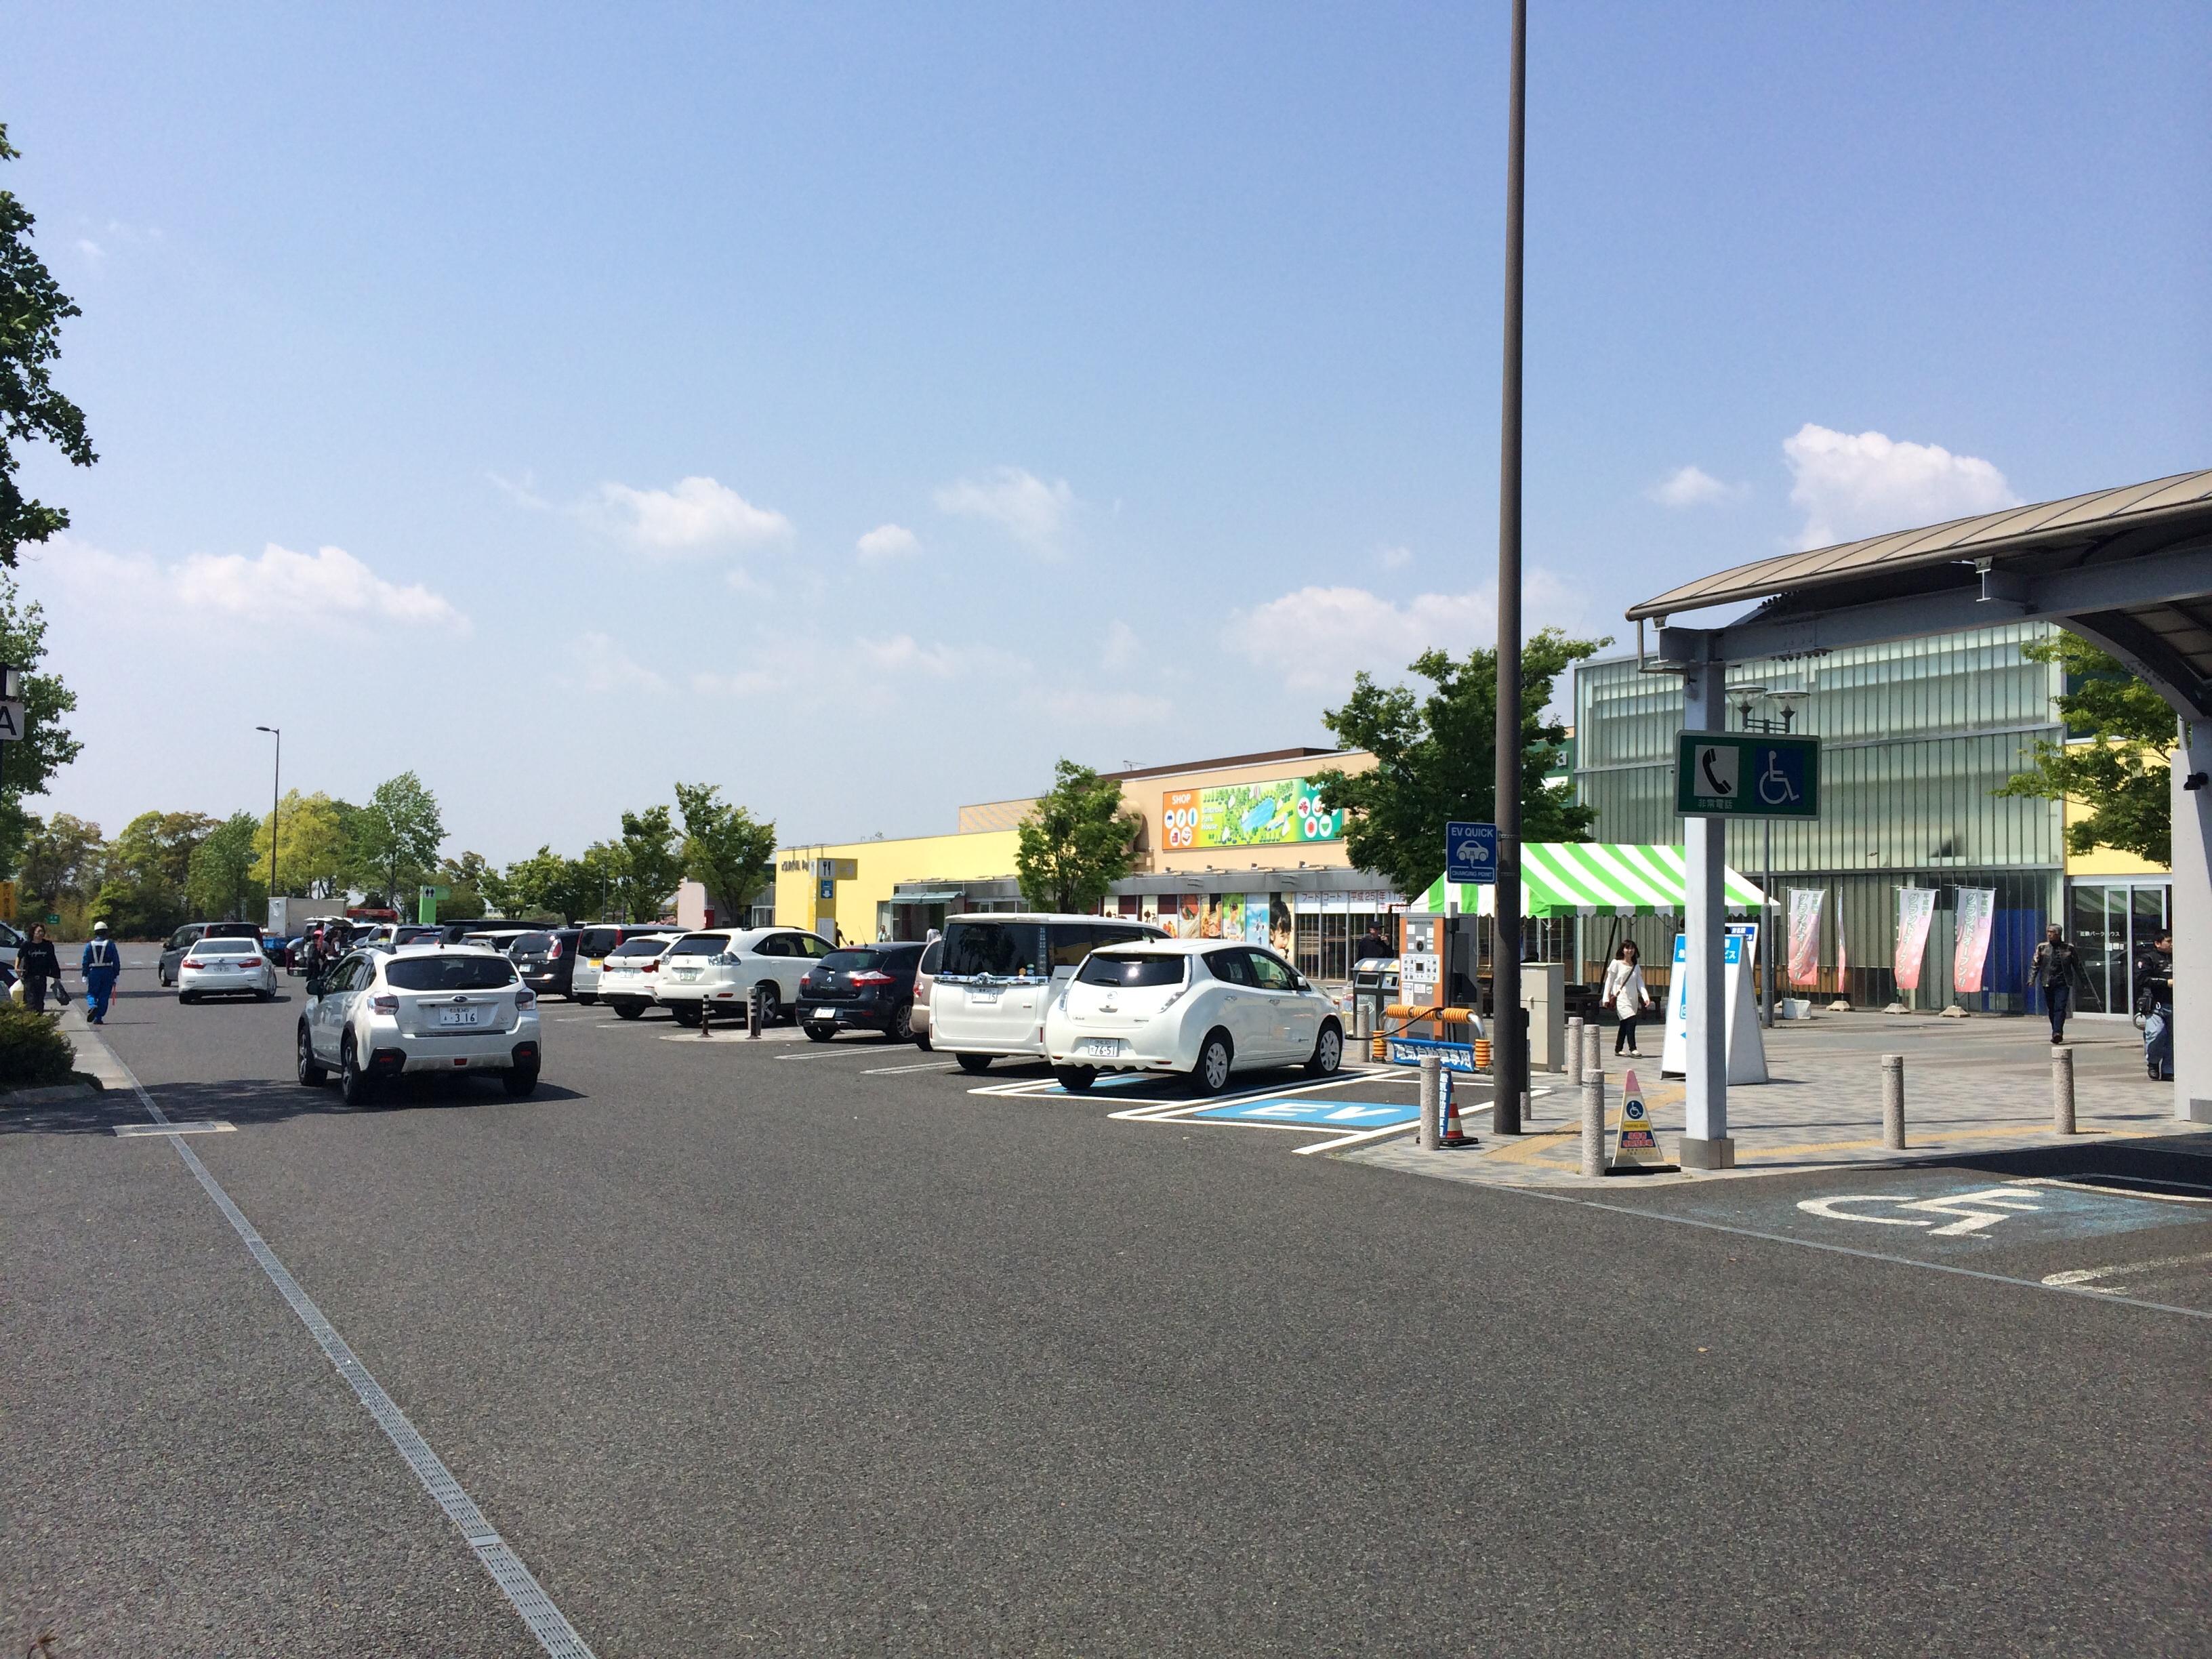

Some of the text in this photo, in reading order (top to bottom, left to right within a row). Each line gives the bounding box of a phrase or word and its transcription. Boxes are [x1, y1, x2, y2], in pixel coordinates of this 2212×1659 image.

[1172, 794, 1191, 805] SHOP
[1697, 799, 1733, 809] 非常電話
[1451, 827, 1494, 838] EV QUICK
[1301, 893, 1342, 902] フードコート
[1240, 1103, 1401, 1120] EV
